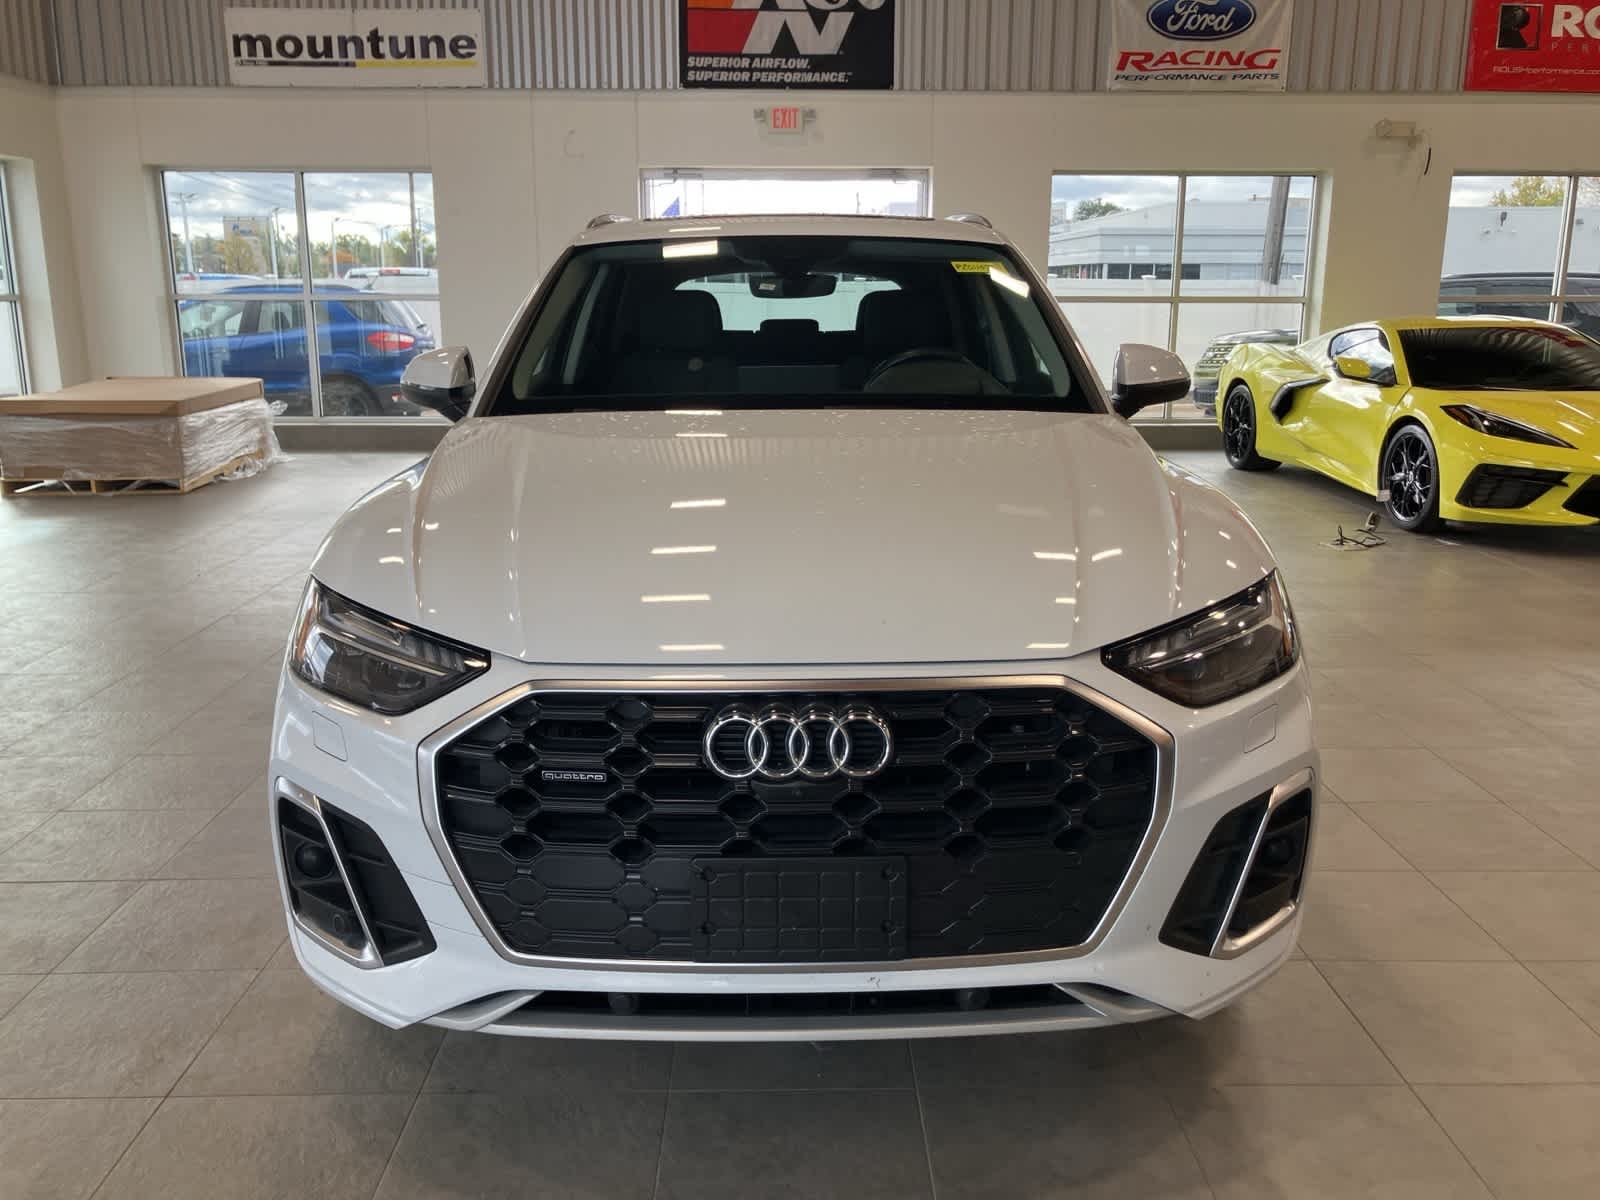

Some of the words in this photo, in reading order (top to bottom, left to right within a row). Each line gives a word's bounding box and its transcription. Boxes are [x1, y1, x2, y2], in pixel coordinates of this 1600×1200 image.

[1166, 0, 1236, 32] Ford
[232, 27, 478, 60] mountune
[687, 57, 750, 68] SUPERIOR
[751, 57, 811, 69] AIRFLOW.
[1116, 48, 1282, 72] RACING
[687, 70, 751, 82] SUPERIOR
[1114, 73, 1227, 81] PERFORMANCE
[772, 108, 799, 129] EXIT
[543, 772, 605, 782] quattro
